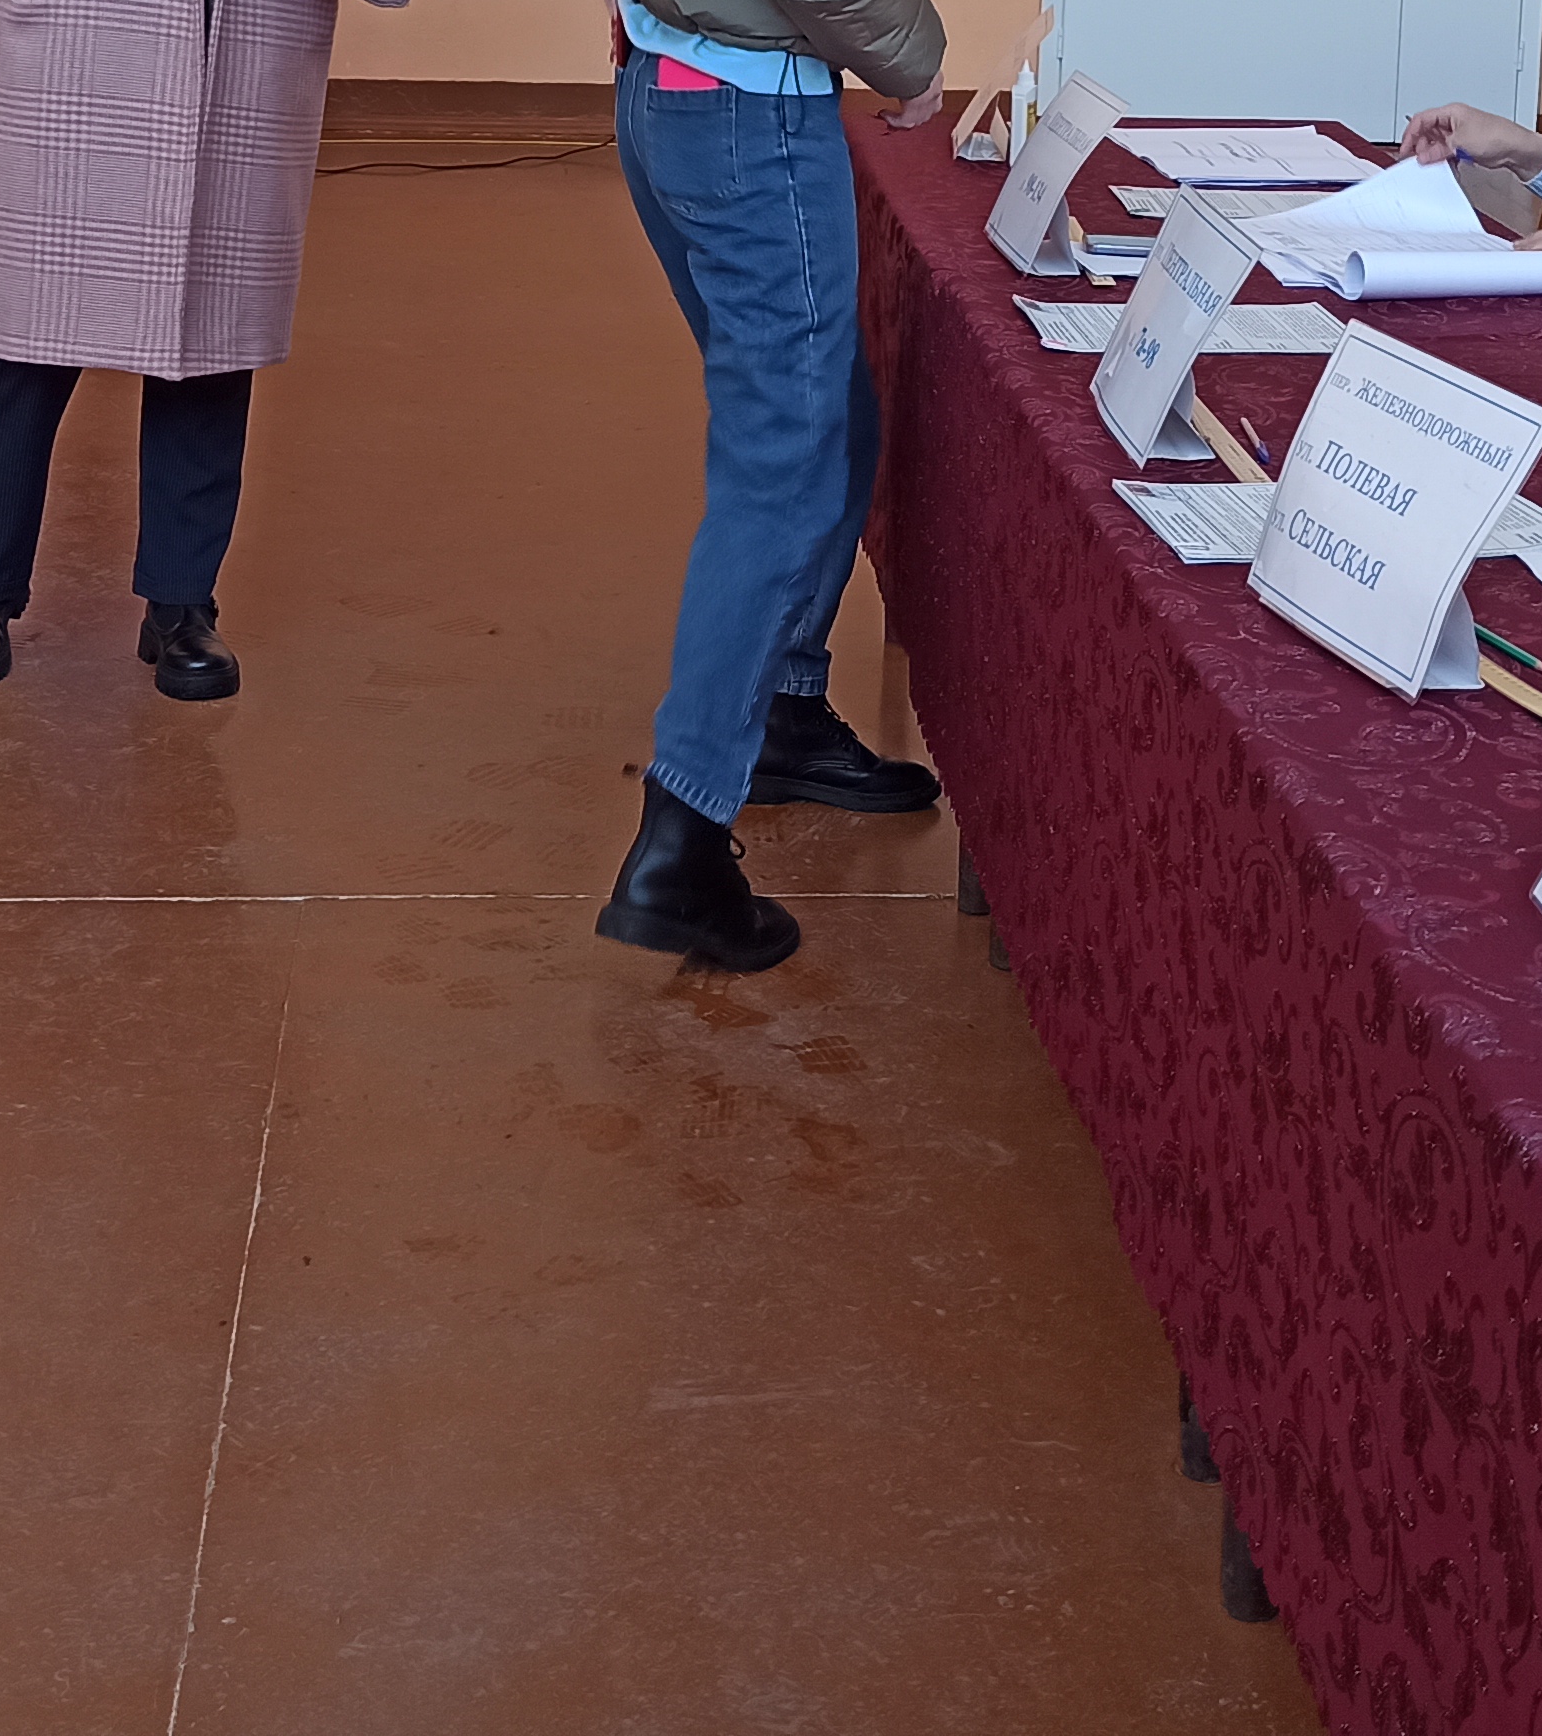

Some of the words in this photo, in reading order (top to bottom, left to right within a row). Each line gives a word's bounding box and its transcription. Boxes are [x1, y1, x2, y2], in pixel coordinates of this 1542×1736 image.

[1160, 242, 1222, 317] ЦЕНТРАЛЬНАЯ
[1354, 377, 1513, 472] ЖЕЛЕЗНОДОРОЖНЫЙ
[1315, 440, 1417, 517] ПОЛЕВАЯ
[1288, 508, 1386, 591] СЕЛЬСКАЯ
